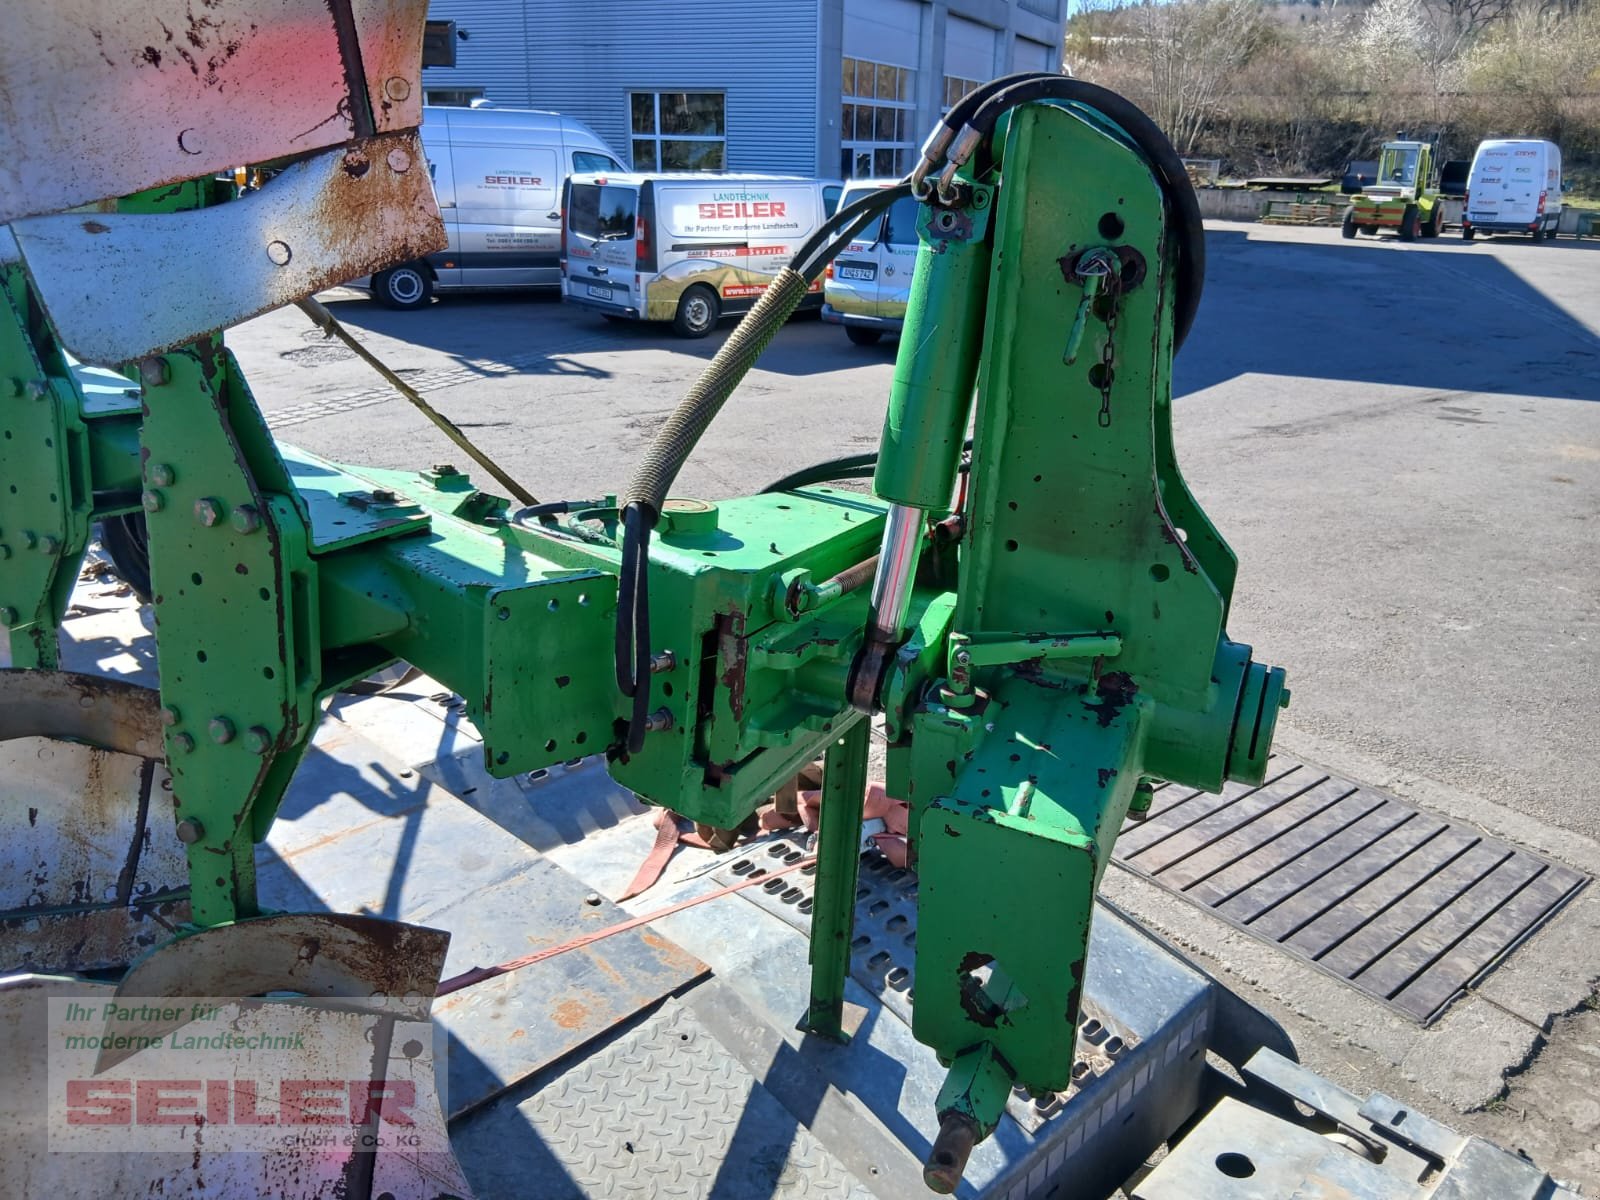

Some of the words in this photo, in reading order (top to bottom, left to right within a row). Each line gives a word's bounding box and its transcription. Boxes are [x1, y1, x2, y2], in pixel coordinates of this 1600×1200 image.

[485, 175, 542, 186] SEILER
[713, 192, 770, 201] LANDTECHNIK
[698, 202, 786, 219] SEILER
[684, 225, 694, 233] Ihr
[696, 225, 720, 233] Partner
[722, 224, 732, 232] für
[762, 222, 798, 230] Landtechnik
[711, 249, 736, 257] STEYR
